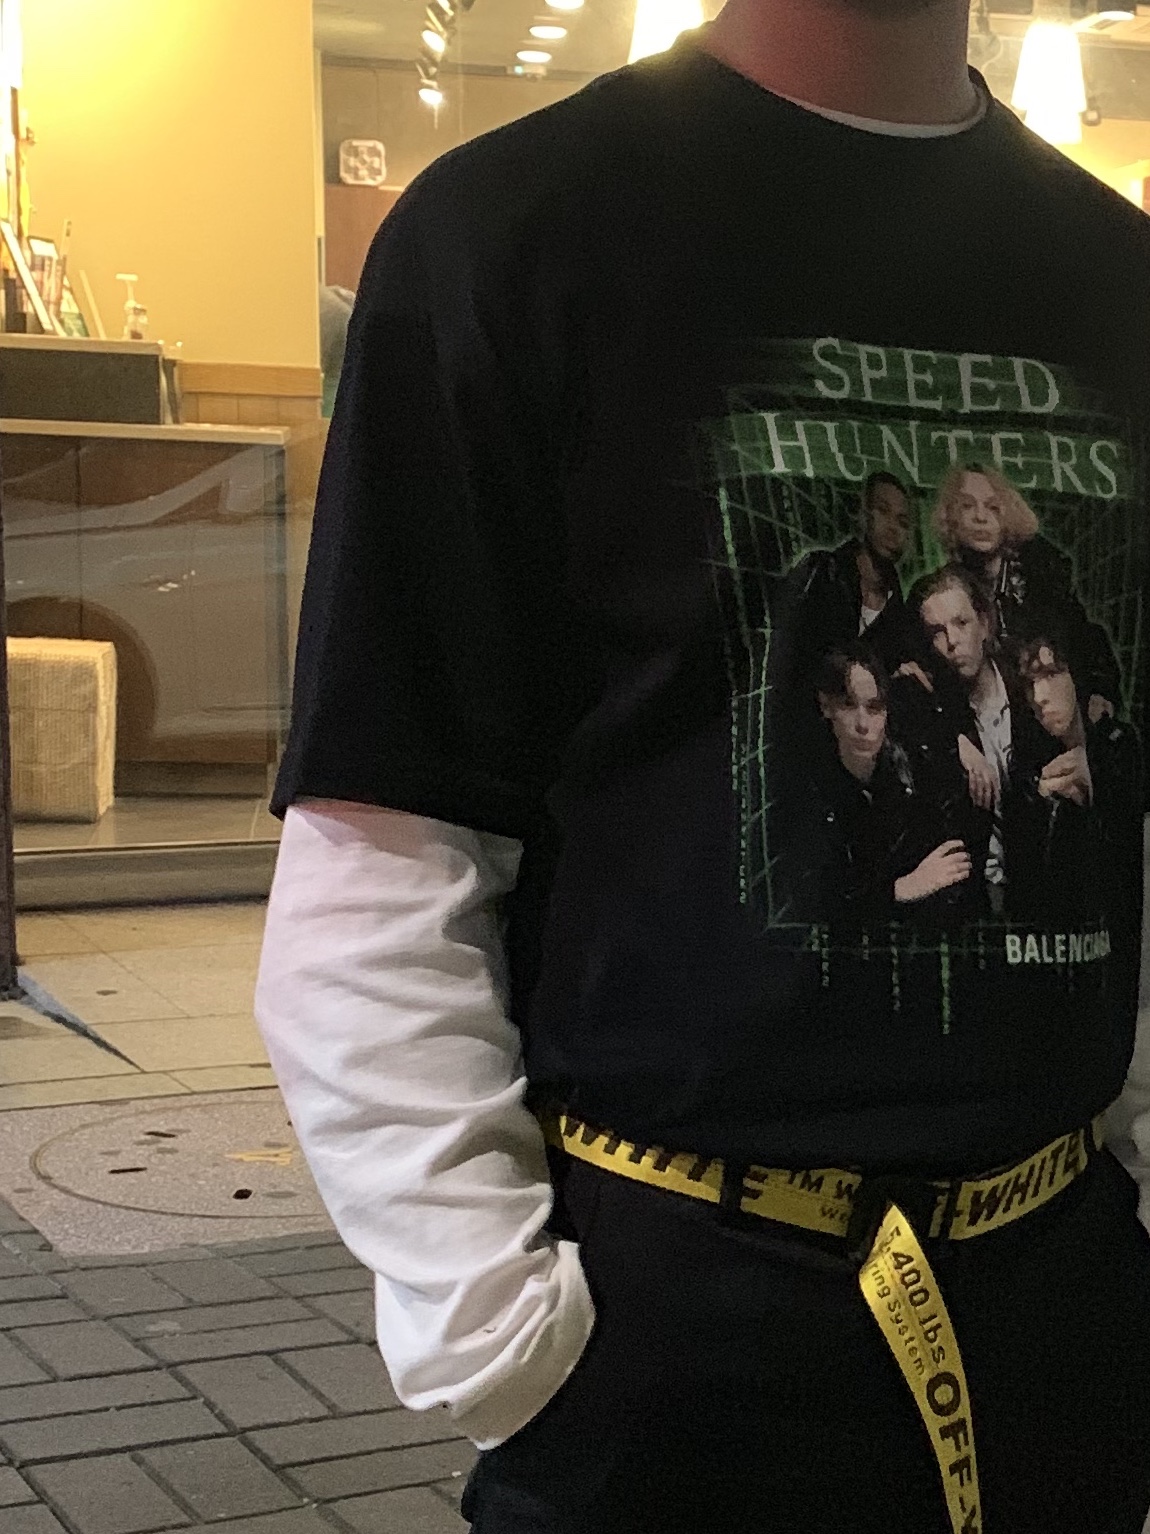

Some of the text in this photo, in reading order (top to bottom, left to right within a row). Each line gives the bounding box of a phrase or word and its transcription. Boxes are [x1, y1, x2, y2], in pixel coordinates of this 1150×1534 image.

[812, 337, 1060, 414] SPEED
[759, 412, 1120, 500] HUNTERS
[887, 1300, 926, 1376] System
[919, 1313, 946, 1365] lbs
